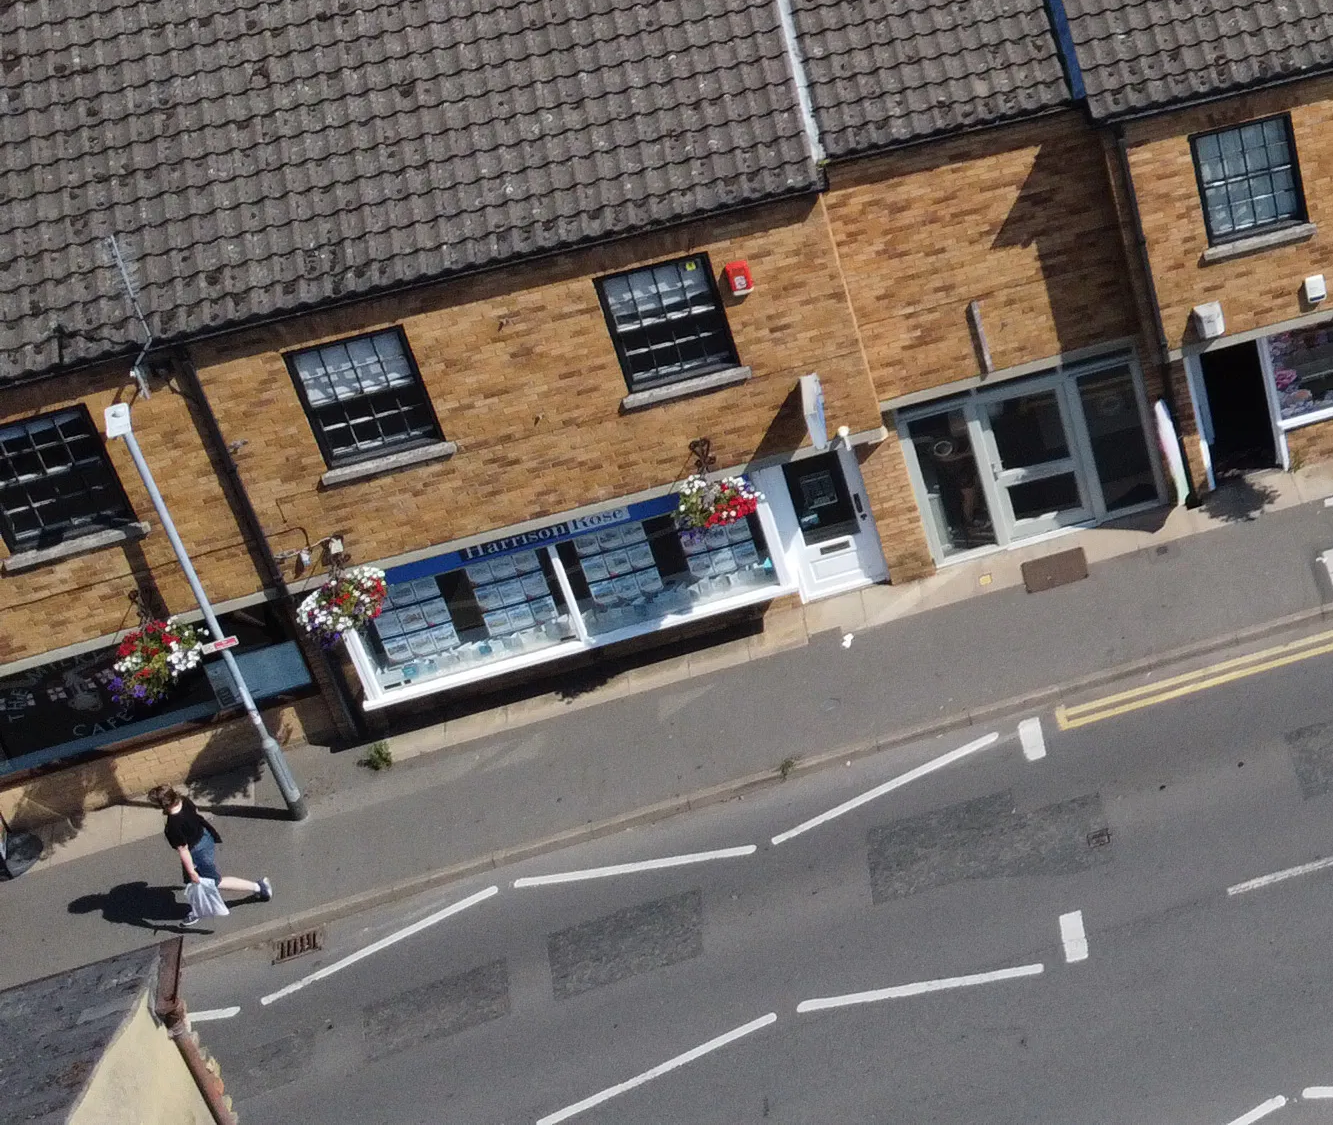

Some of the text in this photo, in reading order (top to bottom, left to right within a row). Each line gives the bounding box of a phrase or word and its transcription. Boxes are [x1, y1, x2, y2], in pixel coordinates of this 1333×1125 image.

[465, 507, 625, 560] Harrison Rose
[7, 688, 28, 724] THE
